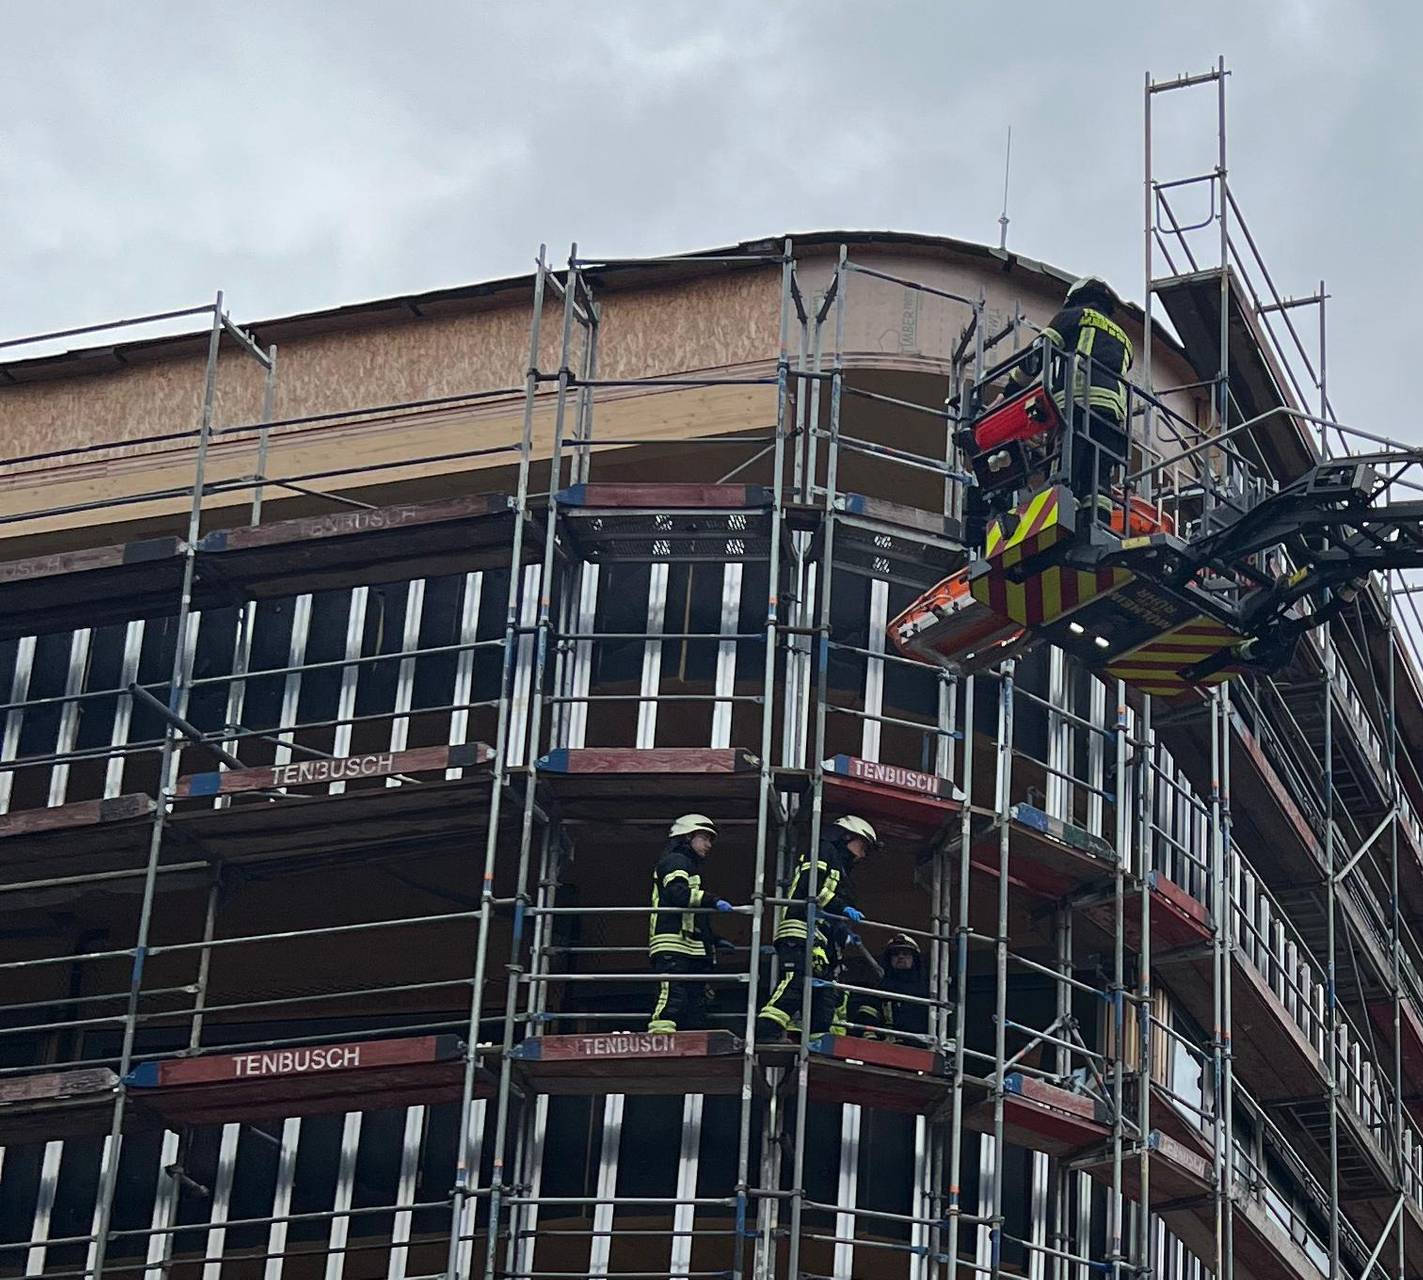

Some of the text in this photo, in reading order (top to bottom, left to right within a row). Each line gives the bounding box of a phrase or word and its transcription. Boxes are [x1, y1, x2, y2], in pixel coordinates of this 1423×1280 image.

[271, 754, 393, 785] TENBUSCH
[855, 760, 938, 794] TENBUSCH
[583, 1034, 675, 1055] TENBUSCH
[232, 1046, 360, 1076] TENBUSCH
